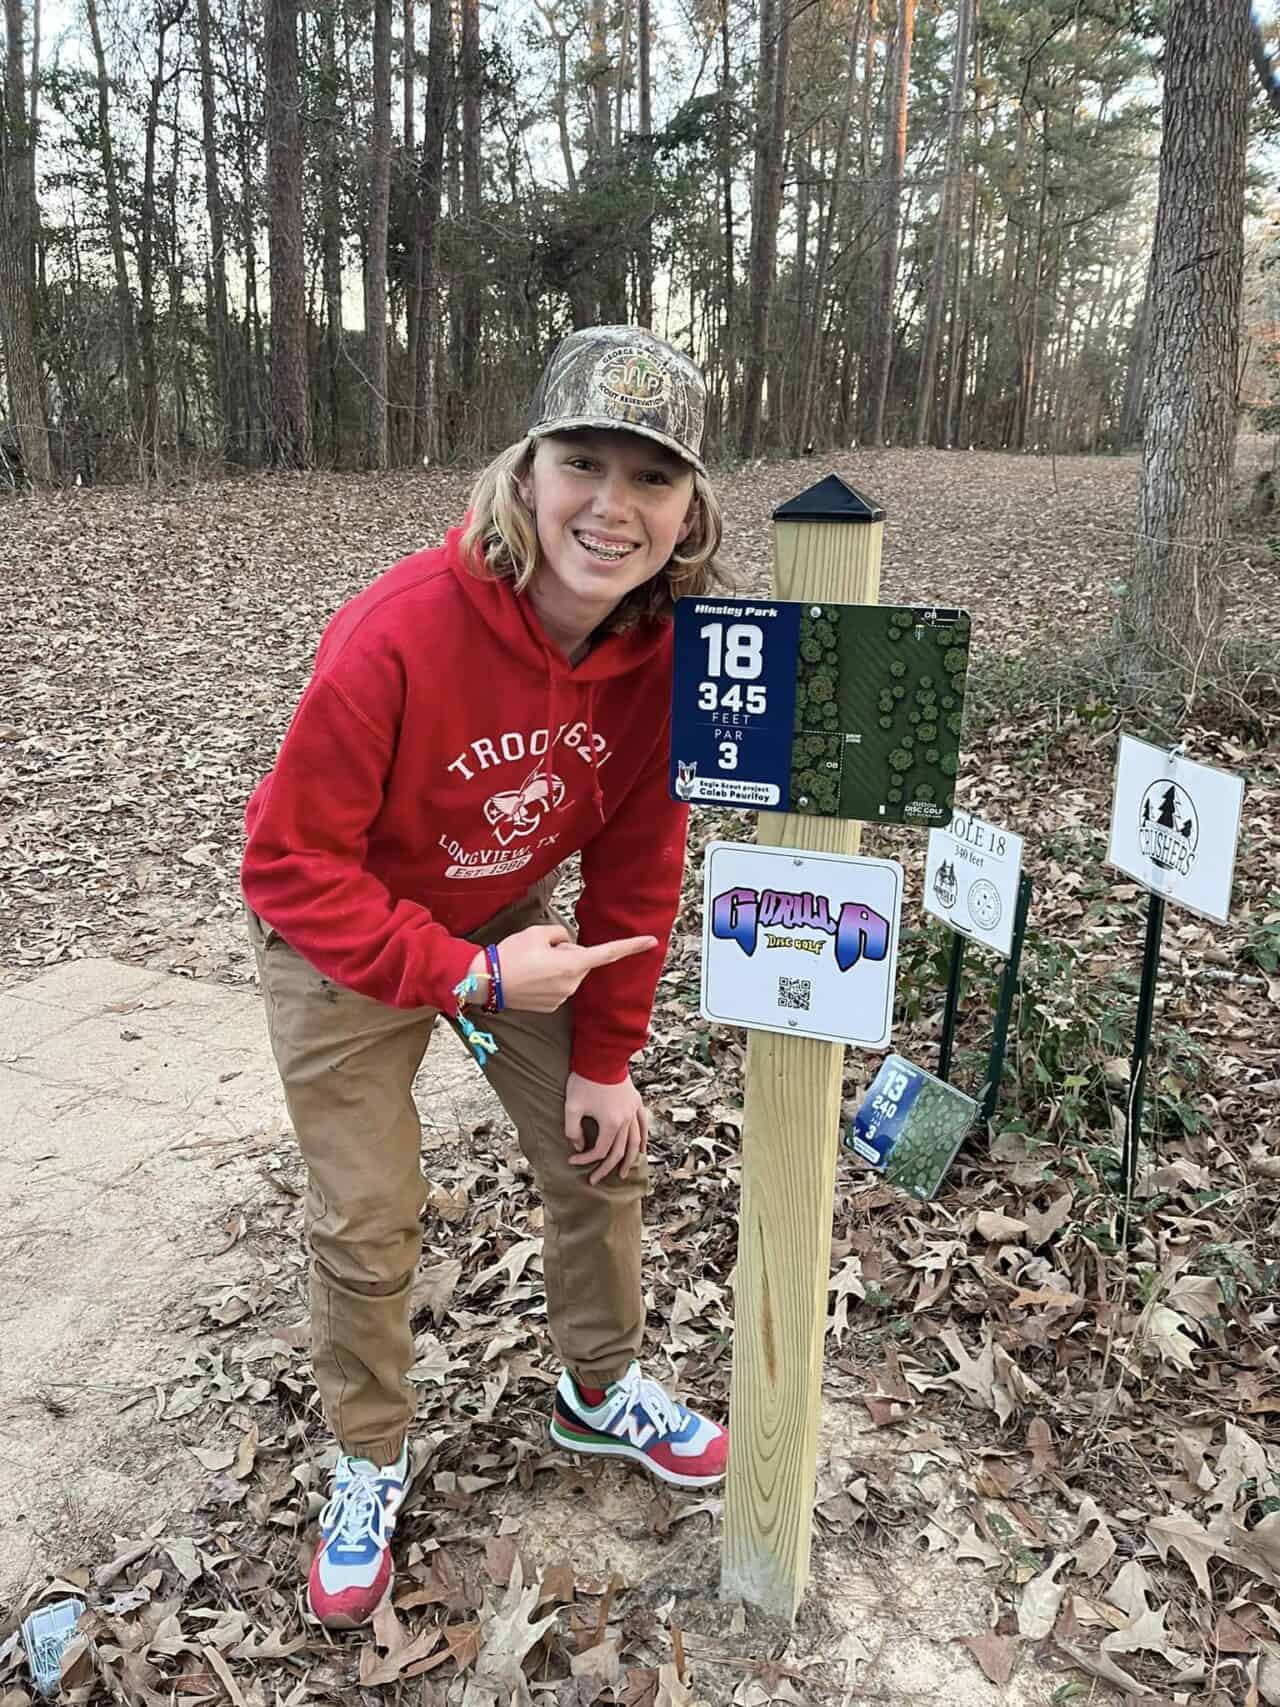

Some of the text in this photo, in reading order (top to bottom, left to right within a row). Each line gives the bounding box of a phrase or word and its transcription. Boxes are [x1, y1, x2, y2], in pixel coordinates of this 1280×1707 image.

[745, 607, 778, 617] Park
[701, 622, 763, 680] 18
[699, 682, 767, 714] 345
[712, 712, 751, 725] FEET
[714, 728, 743, 741] PAR
[447, 723, 568, 780] TROO
[718, 742, 738, 770] 3
[826, 761, 839, 769] OB
[700, 787, 728, 798] Caleb
[721, 782, 741, 790] Scout
[904, 805, 944, 815] DISC GOLF
[989, 833, 1006, 857] 18
[712, 887, 890, 972] GORILLA
[882, 1070, 908, 1102] 13
[872, 1095, 898, 1119] 240
[865, 1125, 877, 1140] 3
[612, 1414, 656, 1448] N
